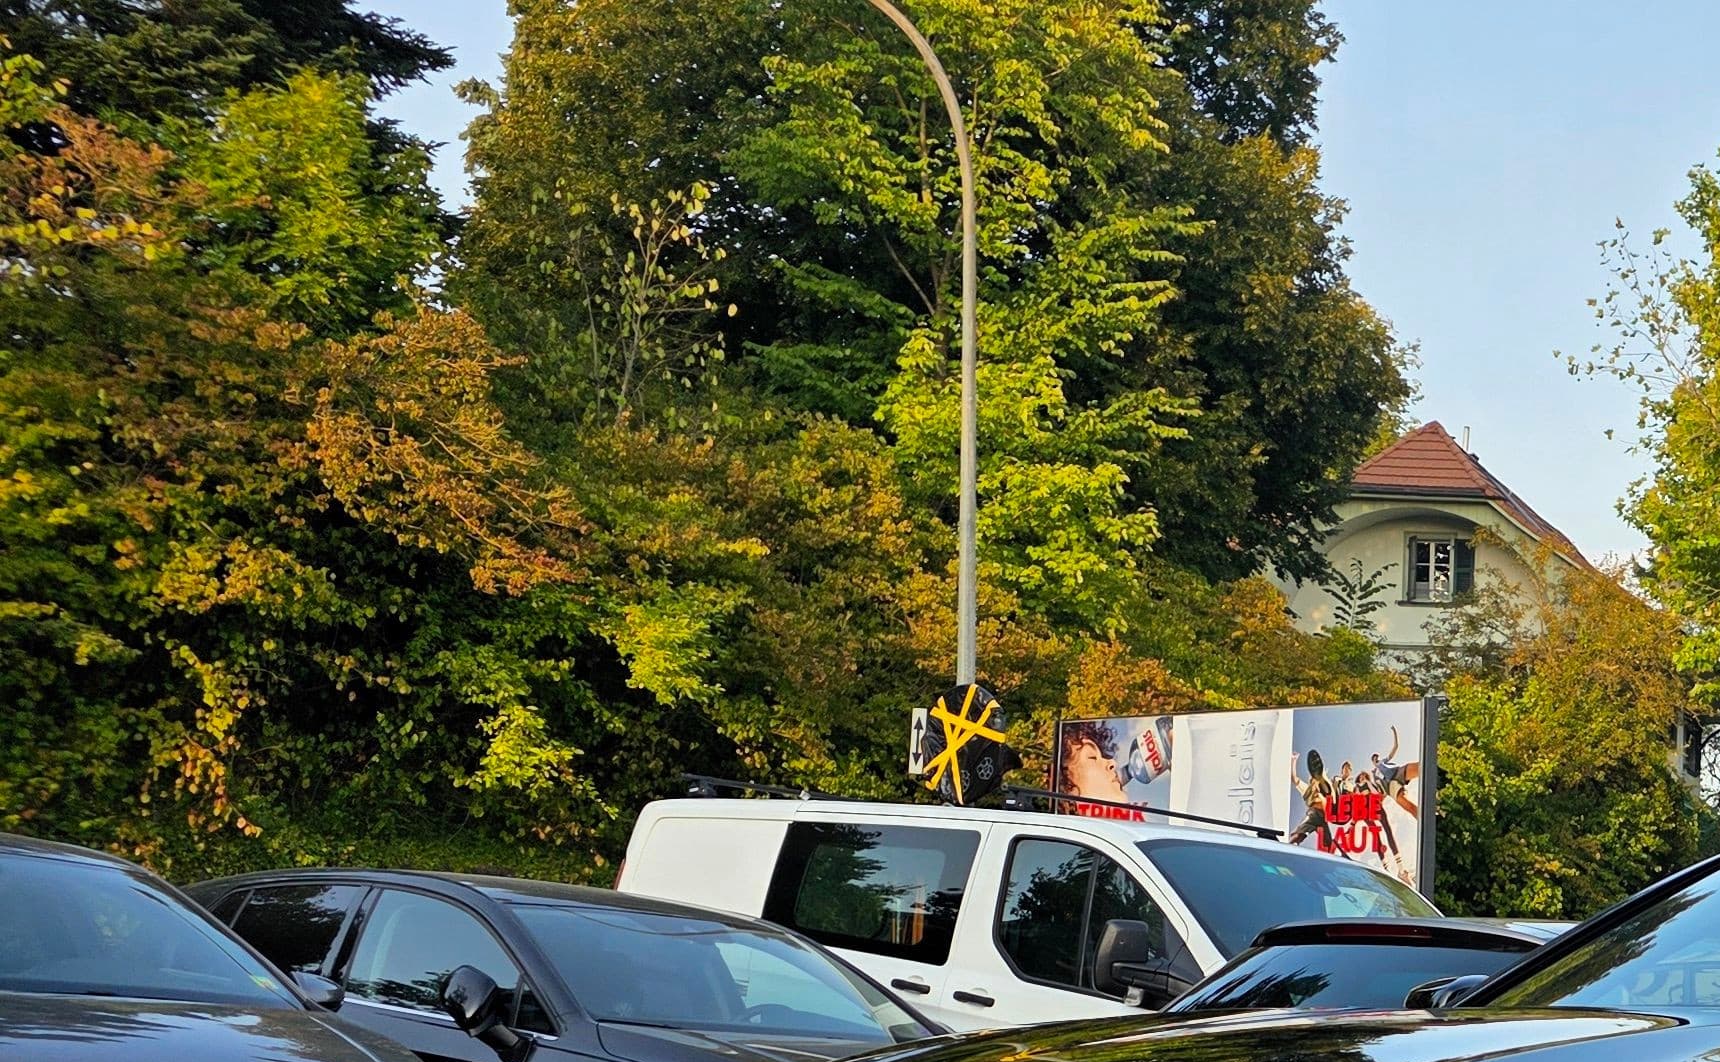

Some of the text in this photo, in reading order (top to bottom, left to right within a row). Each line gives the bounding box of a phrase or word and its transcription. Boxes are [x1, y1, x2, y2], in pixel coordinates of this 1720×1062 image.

[1226, 721, 1256, 825] alais
[1325, 792, 1384, 823] LEBE
[1317, 826, 1387, 854] LAUT.
